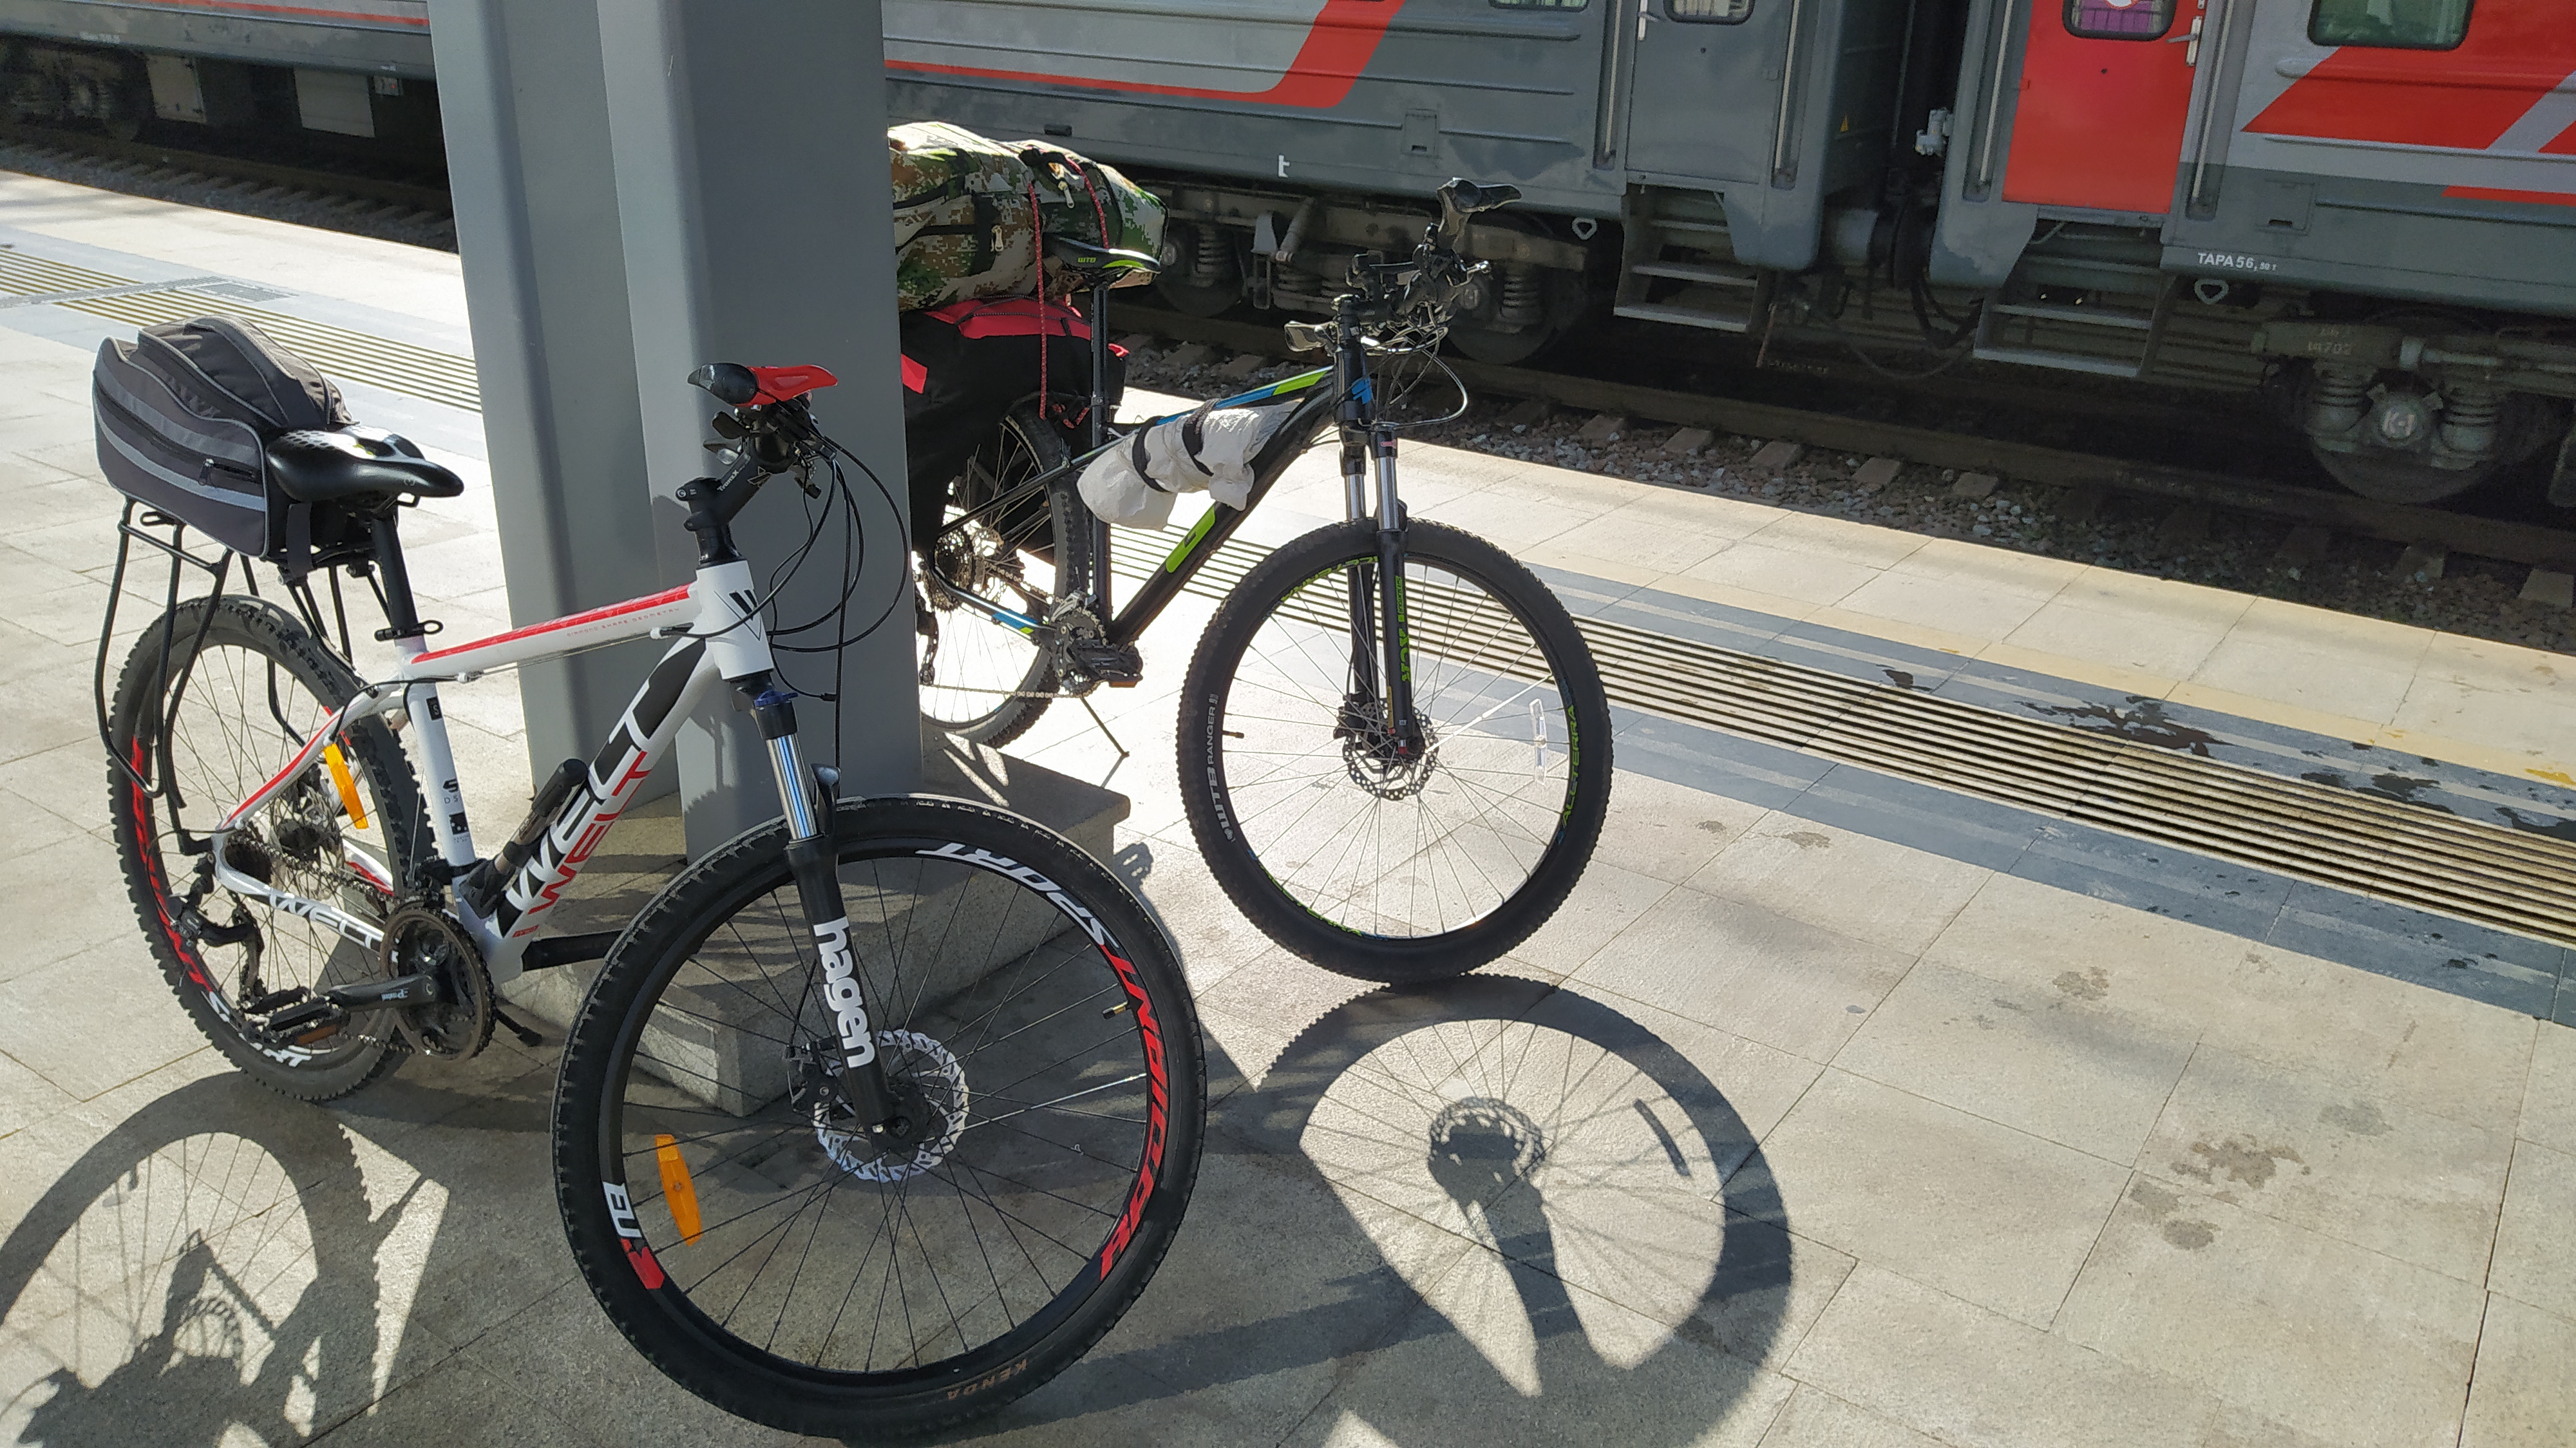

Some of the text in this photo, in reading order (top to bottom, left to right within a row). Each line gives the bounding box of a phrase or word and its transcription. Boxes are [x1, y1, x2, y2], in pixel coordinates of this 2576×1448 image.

[1206, 706, 1217, 765] RANGER
[527, 750, 651, 915] WELT
[269, 887, 383, 949] WELT
[915, 843, 1120, 948] SPORT
[200, 991, 312, 1067] SRT
[813, 916, 875, 1069] hagen
[1099, 944, 1168, 1281] RADIANT
[947, 1358, 1027, 1400] KENDA
